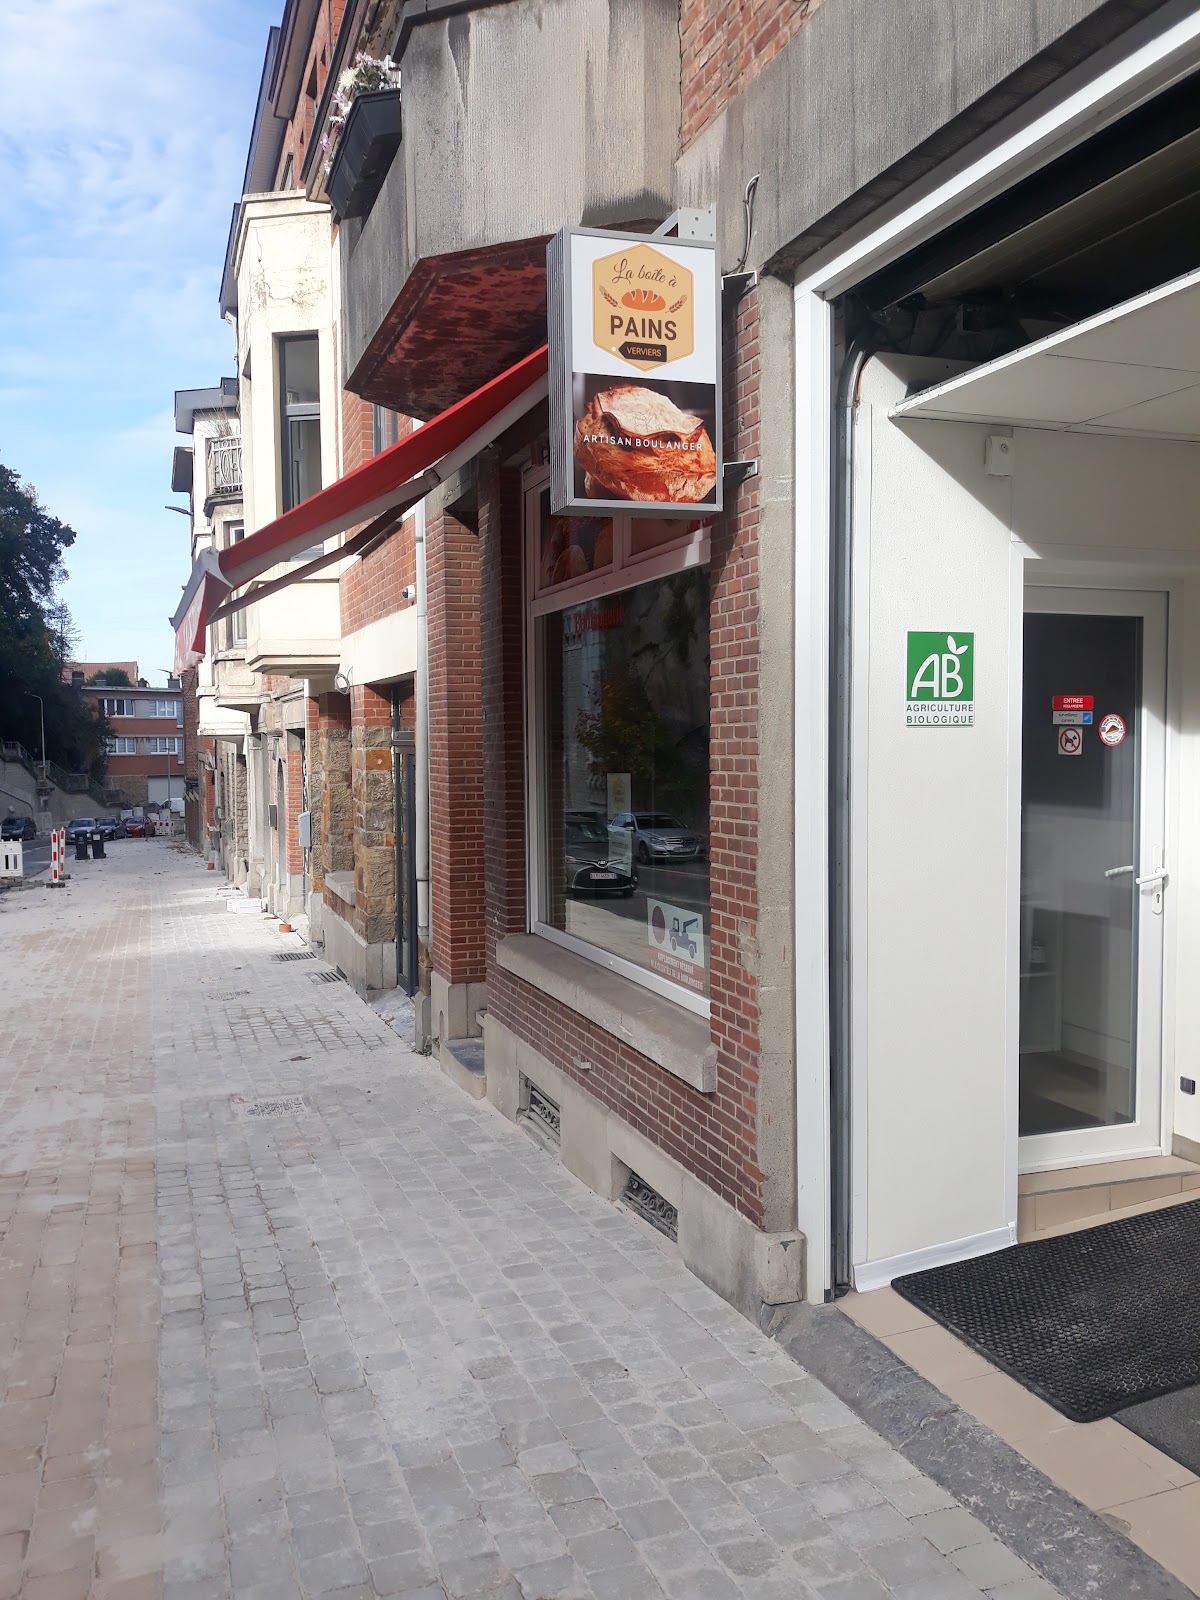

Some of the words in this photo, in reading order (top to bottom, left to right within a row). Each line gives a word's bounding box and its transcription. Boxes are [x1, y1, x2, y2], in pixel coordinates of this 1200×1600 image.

[611, 258, 634, 285] La
[637, 264, 666, 283] boîte
[668, 275, 678, 287] à
[610, 314, 677, 341] PAINS
[626, 345, 662, 357] VERVIERS
[583, 434, 632, 446] ARTISAN
[635, 438, 703, 451] BOULANGER
[911, 653, 964, 698] AB
[906, 704, 974, 712] AGRICULTURE
[906, 715, 974, 724] BIOLOGIQUE
